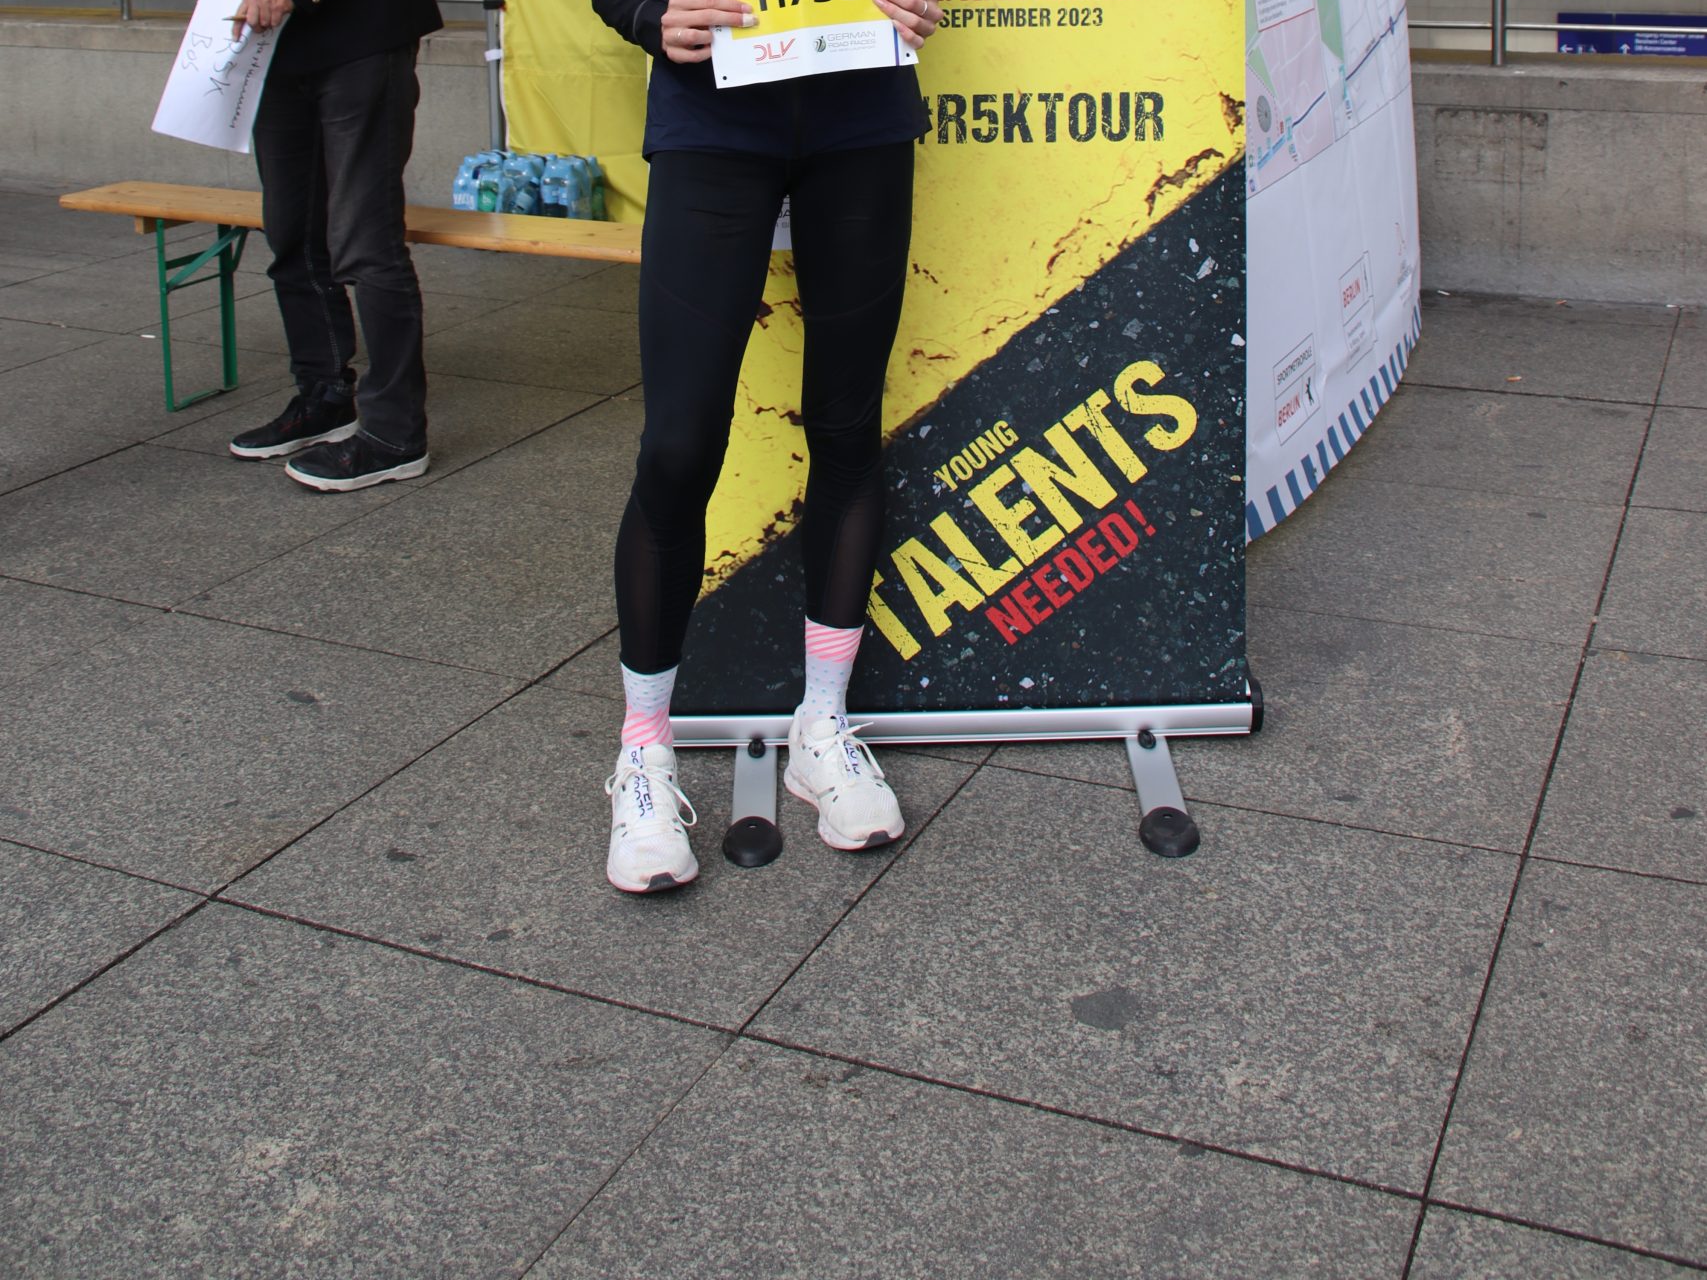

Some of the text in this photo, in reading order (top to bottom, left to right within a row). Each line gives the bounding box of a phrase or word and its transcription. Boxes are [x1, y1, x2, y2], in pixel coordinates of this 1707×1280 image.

[938, 7, 1104, 29] SEPTEMBER 2023
[827, 31, 876, 42] GERMAN
[1342, 277, 1362, 308] BERLIN
[1277, 394, 1302, 428] BERLIN
[933, 419, 1020, 492] YOUNG
[865, 359, 1199, 661] TALENTS
[983, 499, 1157, 646] NEEDED!
